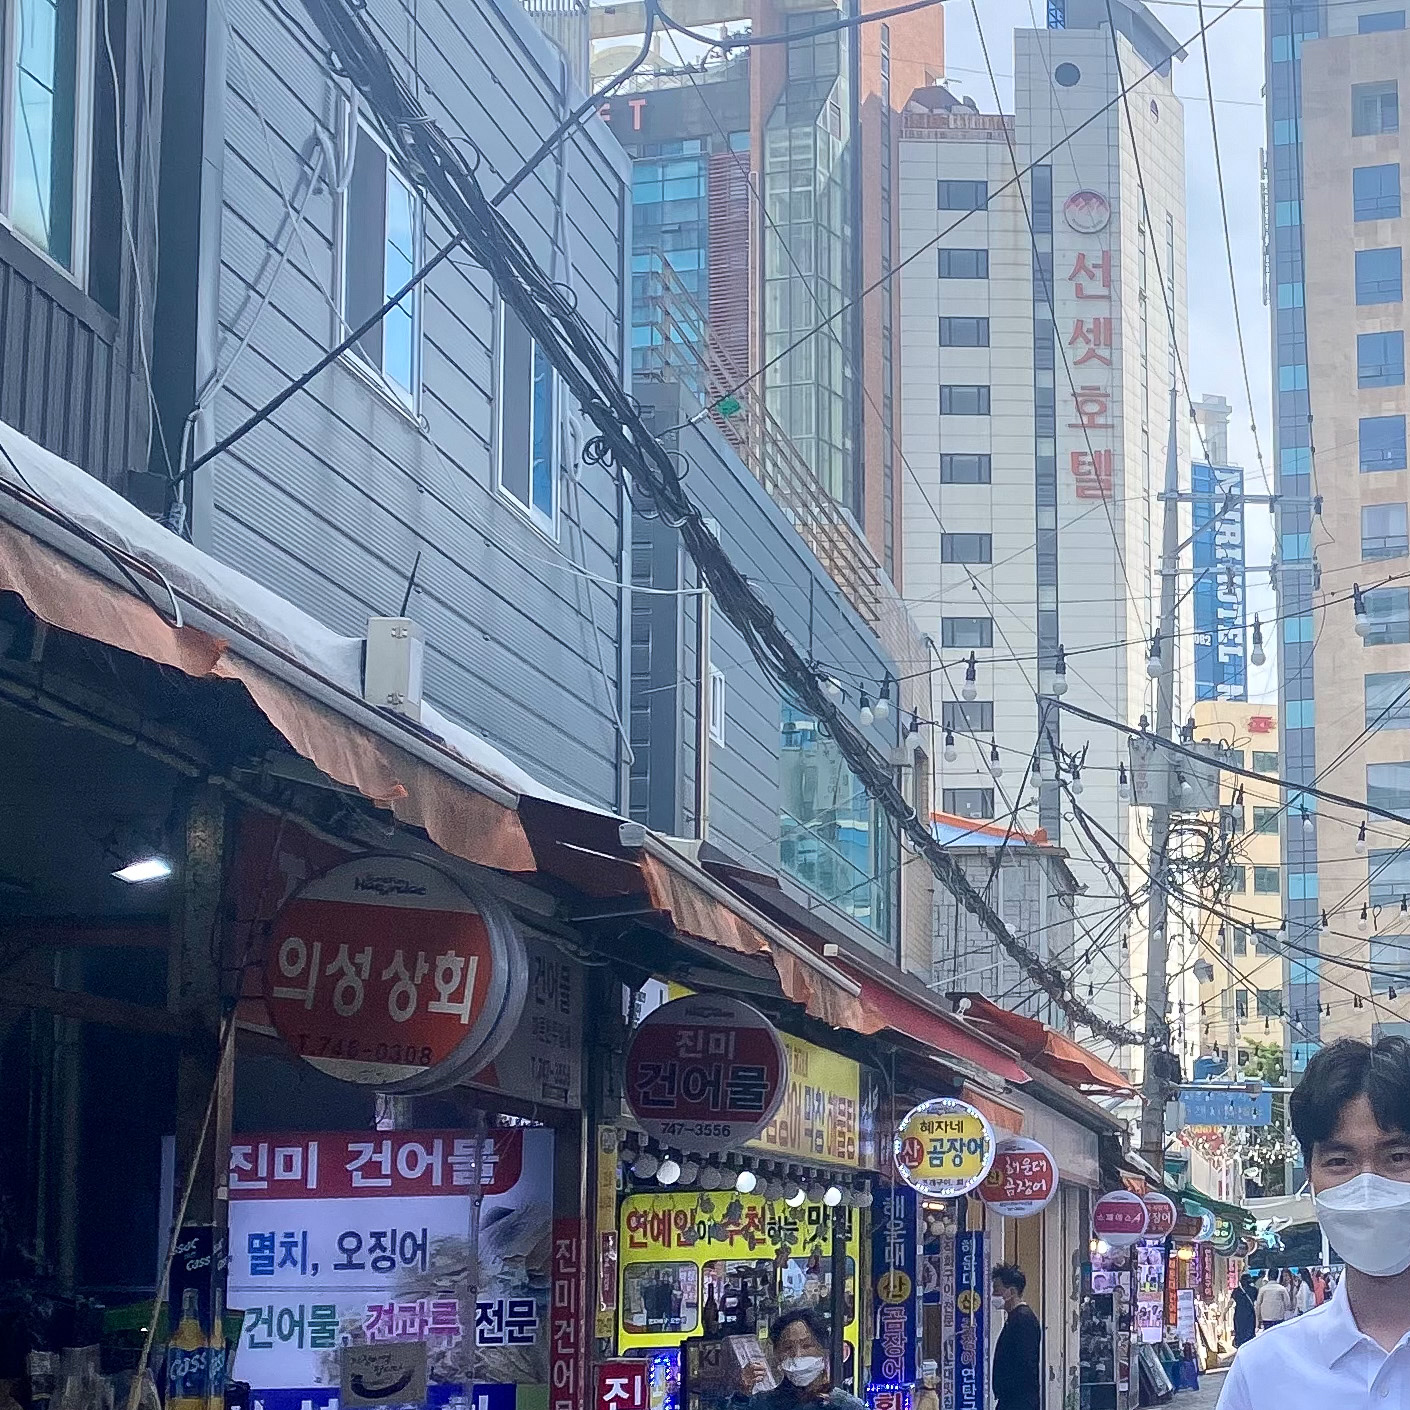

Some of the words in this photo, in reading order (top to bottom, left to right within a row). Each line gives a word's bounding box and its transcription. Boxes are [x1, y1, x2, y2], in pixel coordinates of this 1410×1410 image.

[271, 936, 480, 1026] 의성상회
[675, 1029, 737, 1060] 진미
[634, 1060, 771, 1113] 건어물
[660, 1122, 732, 1138] 747-3556
[919, 1119, 965, 1135] 혜자네
[228, 1136, 319, 1191] 진미
[343, 1138, 500, 1191] 건어물
[926, 1137, 985, 1168] 곰장어
[331, 1227, 430, 1275] 오징어
[474, 1298, 538, 1347] 전문
